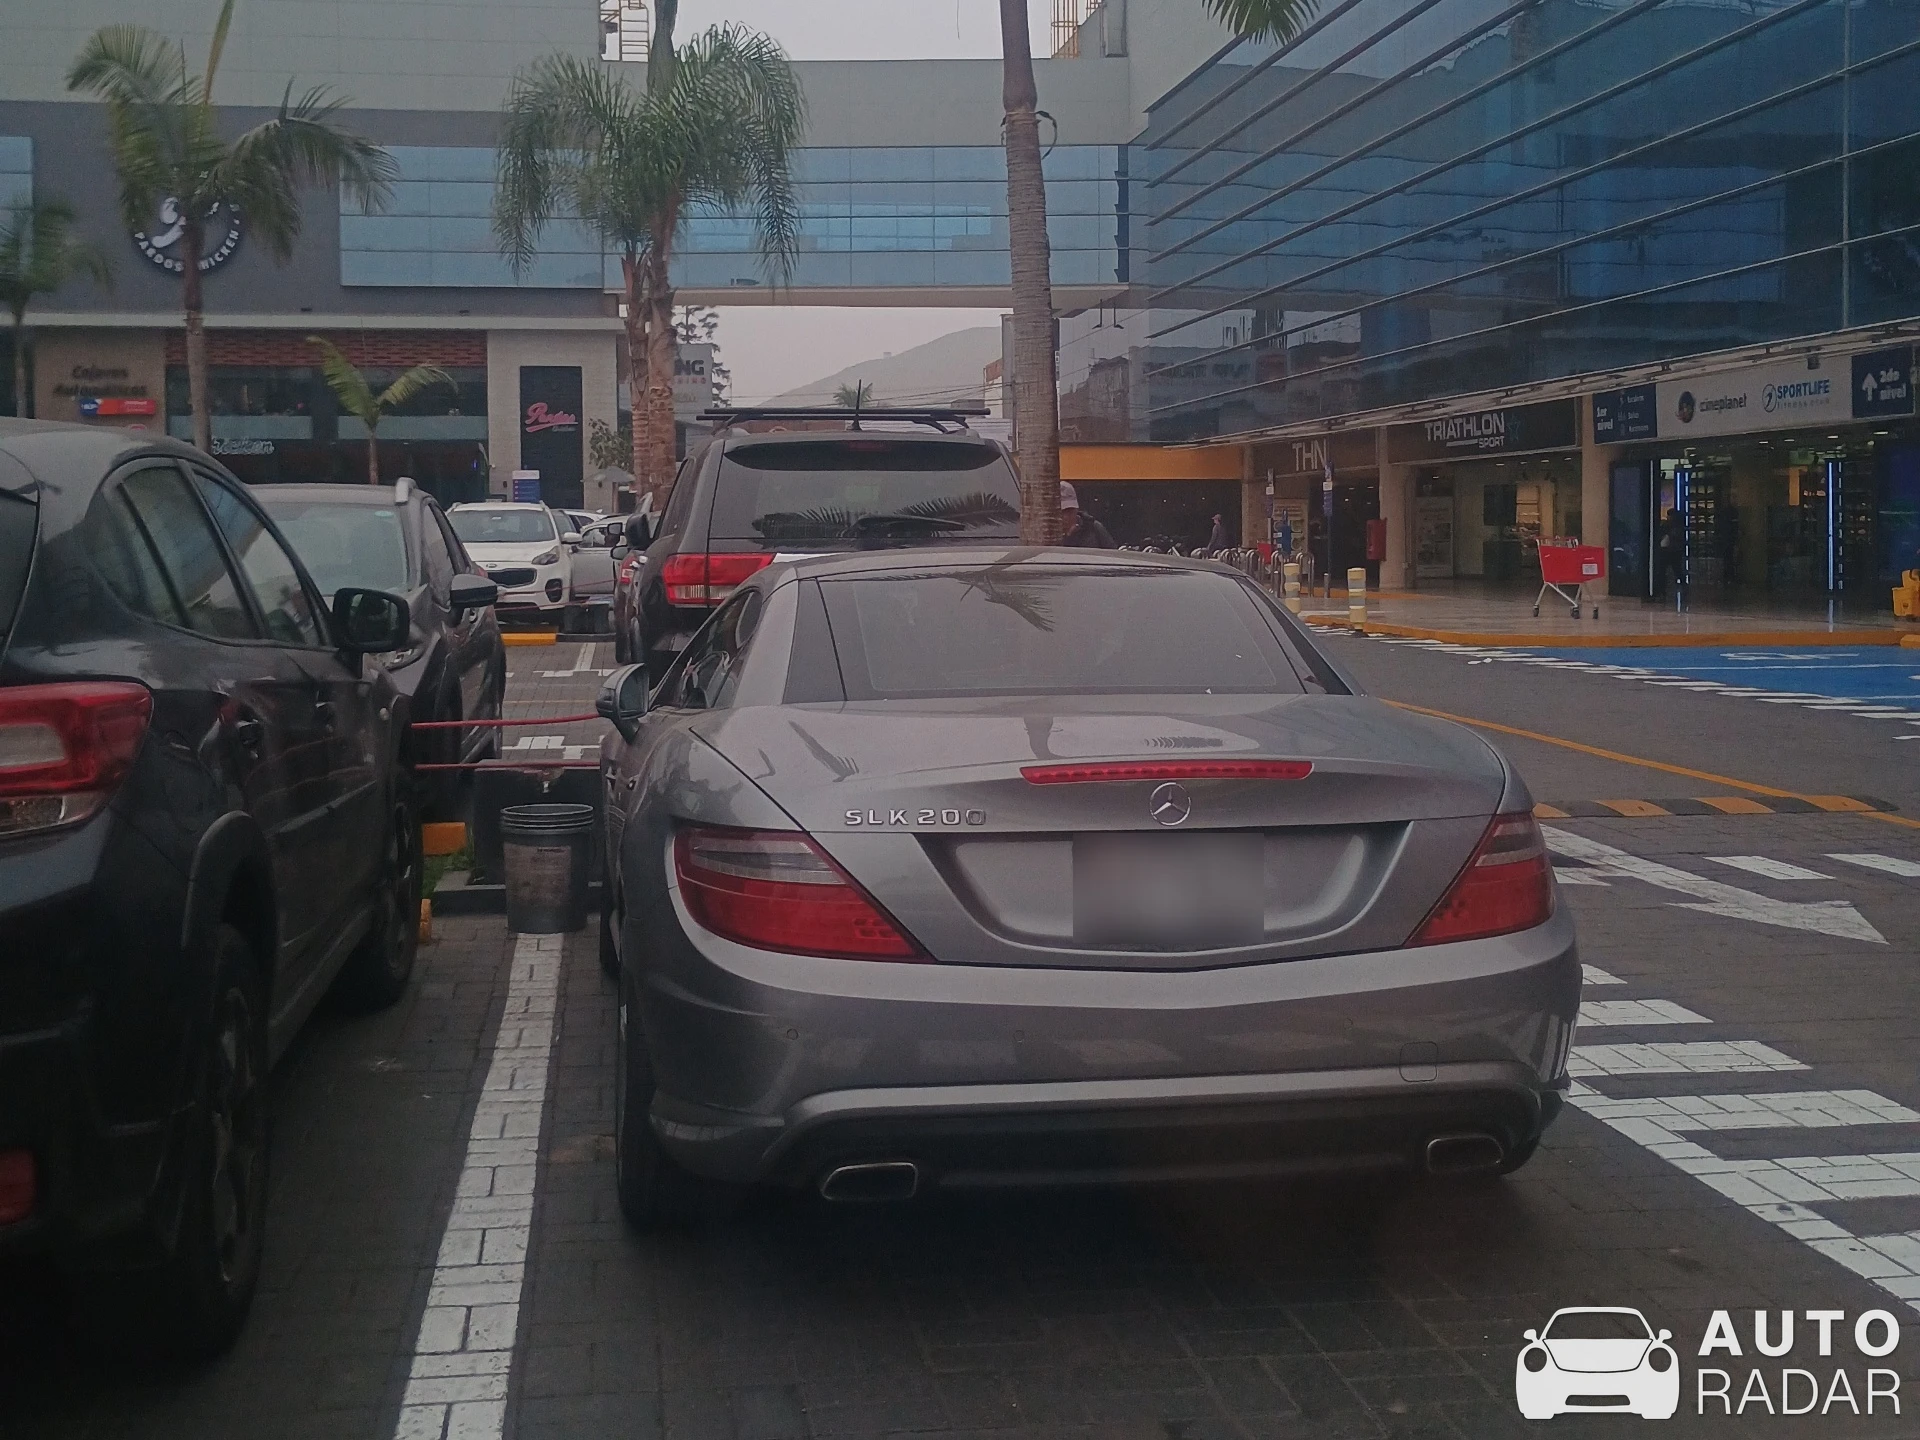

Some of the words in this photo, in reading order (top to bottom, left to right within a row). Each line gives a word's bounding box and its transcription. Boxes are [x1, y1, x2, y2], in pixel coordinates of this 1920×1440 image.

[196, 229, 239, 270] HICKEN
[674, 360, 704, 375] NG
[1777, 379, 1830, 399] SPORTLIFE
[1699, 393, 1747, 413] cineplanet
[1424, 411, 1505, 442] TRIATHLON
[1478, 435, 1504, 449] SPORT
[1292, 438, 1327, 471] THN
[844, 808, 909, 826] SLK
[916, 808, 986, 826] 200
